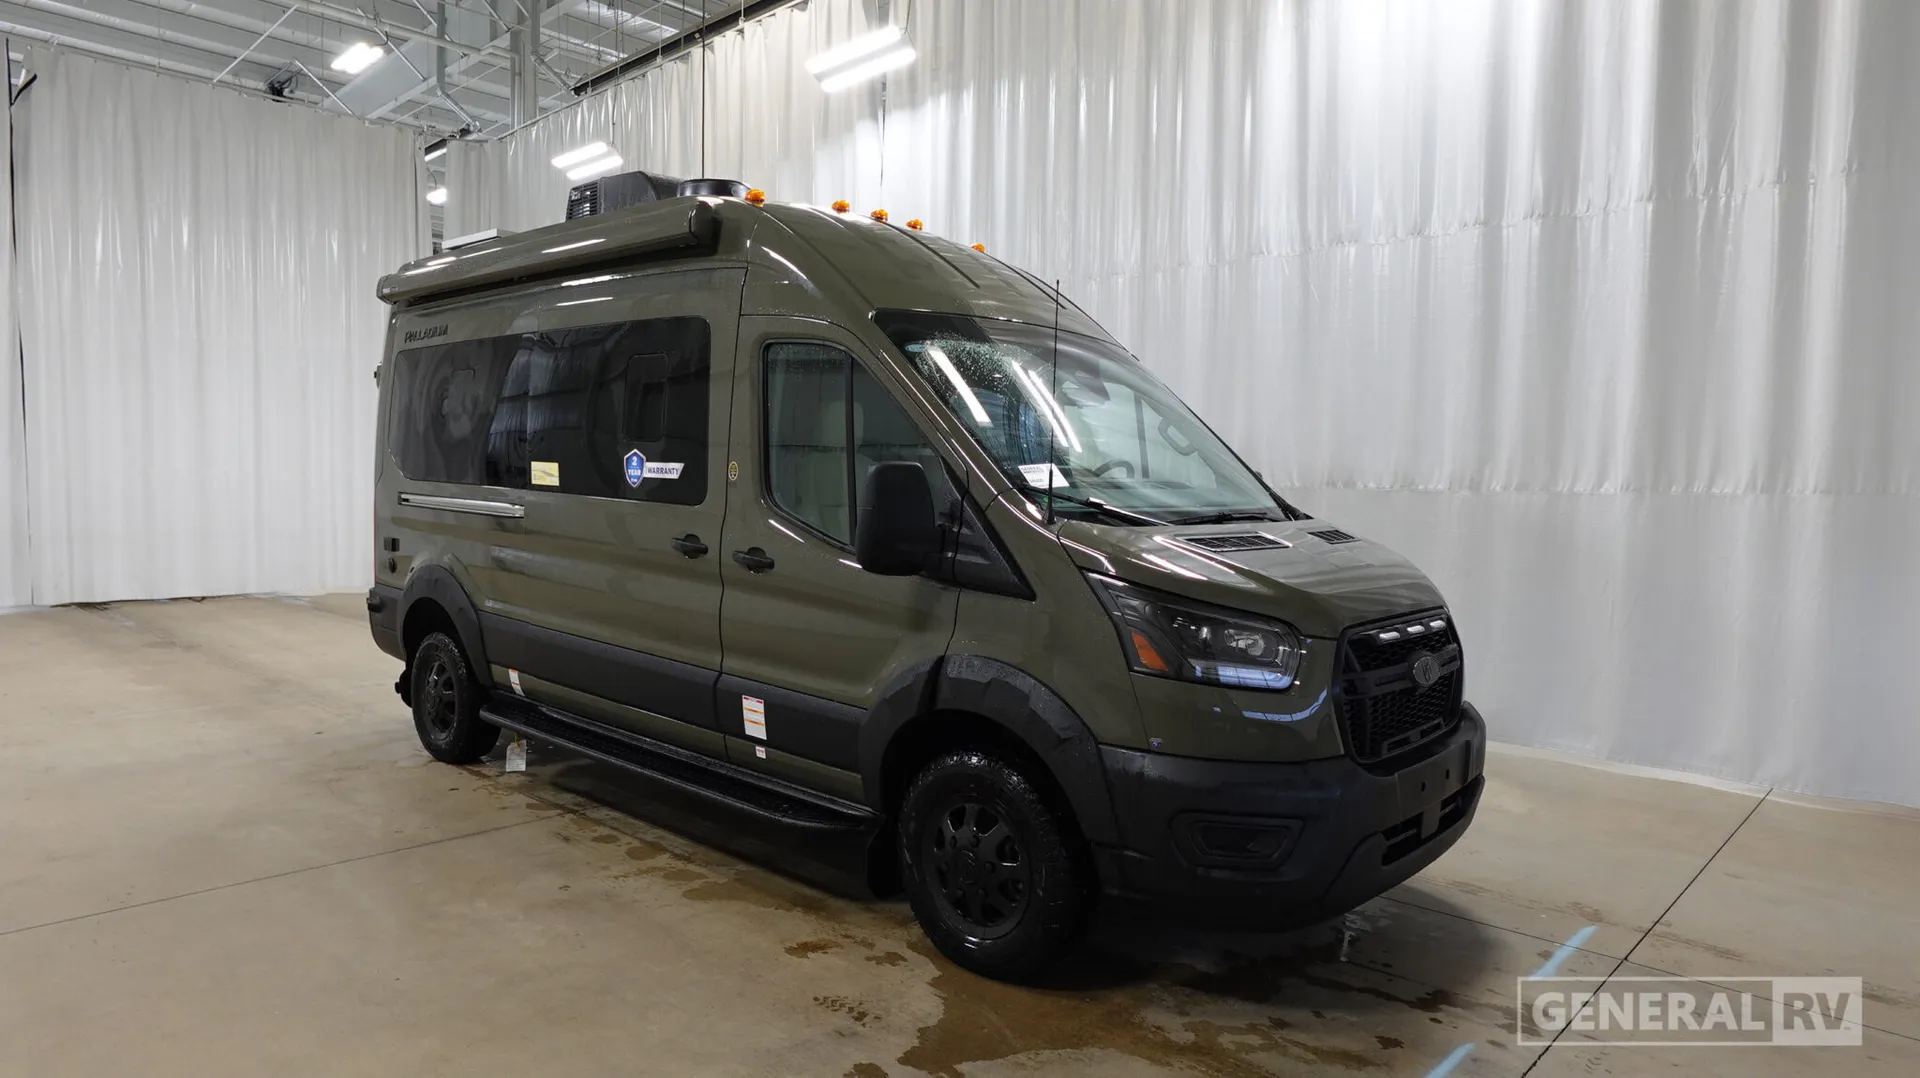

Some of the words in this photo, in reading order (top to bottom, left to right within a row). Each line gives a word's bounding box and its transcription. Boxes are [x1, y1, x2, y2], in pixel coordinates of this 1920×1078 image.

[404, 324, 449, 344] PALLADIUM
[632, 456, 638, 466] 2
[647, 467, 680, 475] WARRANTY
